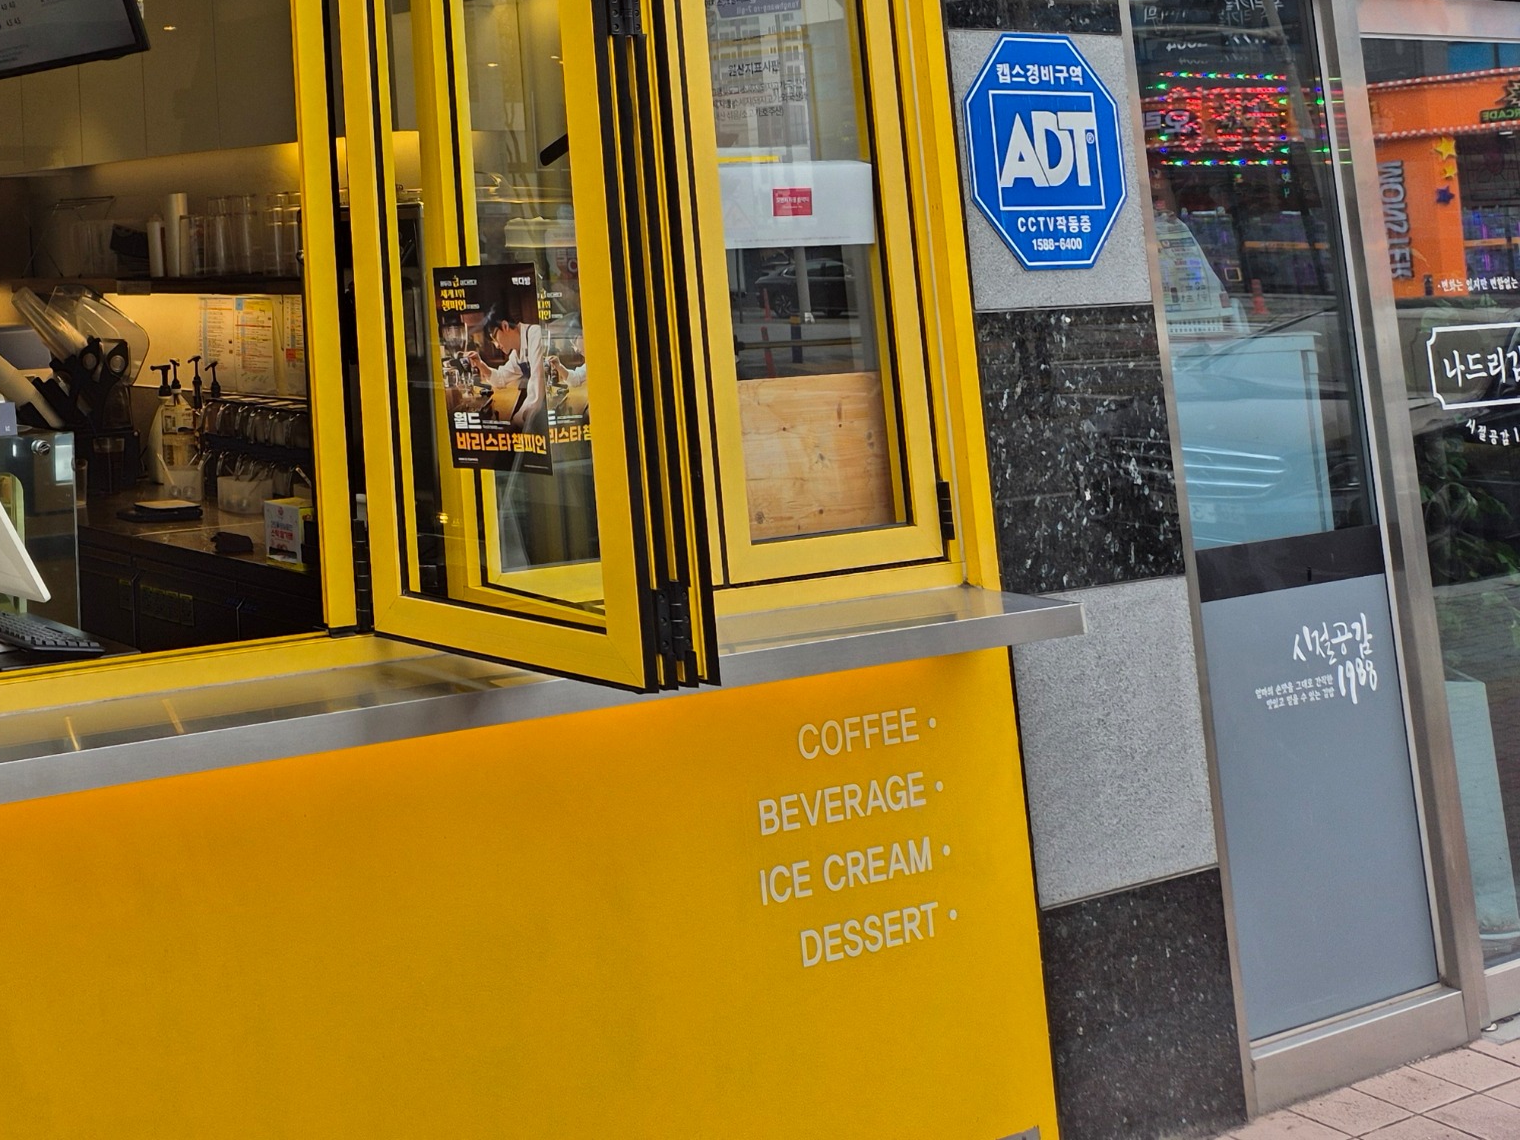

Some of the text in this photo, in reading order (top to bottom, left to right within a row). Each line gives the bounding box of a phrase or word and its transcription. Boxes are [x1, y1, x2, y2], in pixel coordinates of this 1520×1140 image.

[996, 63, 1084, 85] 캡스경비구역
[1159, 86, 1280, 153] 영업중
[1000, 111, 1096, 187] ADT
[1018, 215, 1091, 233] CCTV작동중
[1032, 238, 1083, 251] 1588-6400
[454, 411, 482, 429] 월드
[1465, 418, 1510, 447] 시절공감
[1293, 612, 1373, 665] 시절공감
[1295, 678, 1314, 690] 그대로
[1301, 692, 1307, 703] 수
[1338, 657, 1377, 704] 1988
[798, 708, 919, 759] COFFEE
[759, 771, 927, 836] BEVERAGE
[760, 836, 933, 906] ICE CREAM
[800, 901, 938, 967] DESSERT
